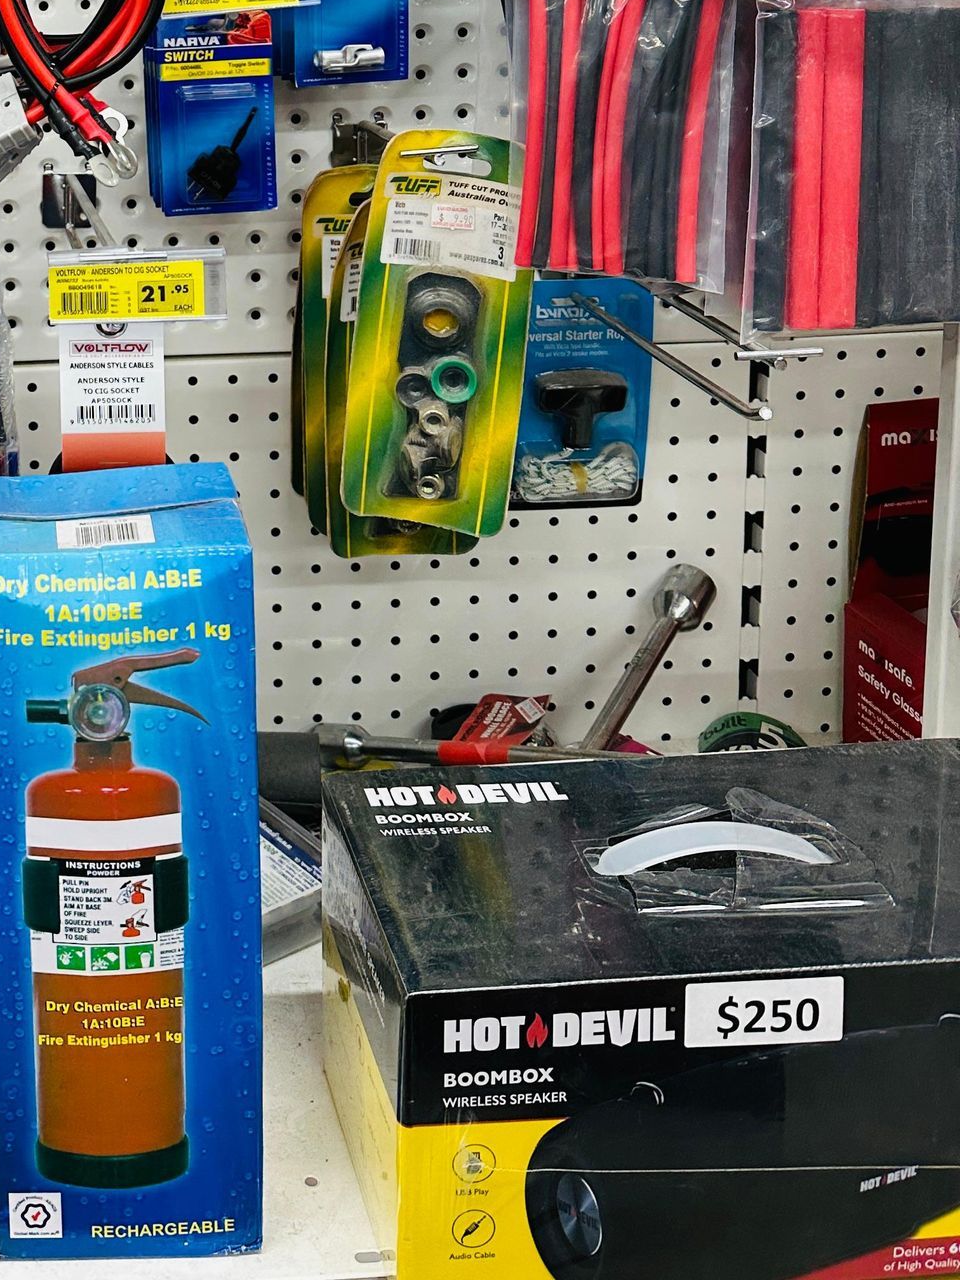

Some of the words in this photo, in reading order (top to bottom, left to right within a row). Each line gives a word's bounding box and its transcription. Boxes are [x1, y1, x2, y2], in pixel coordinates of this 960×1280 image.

[164, 36, 220, 46] NARVA
[164, 50, 214, 62] SWITCH
[390, 177, 441, 194] TUFF
[448, 181, 469, 189] TUFF
[471, 183, 488, 192] CUT
[448, 190, 496, 203] Australian
[566, 330, 603, 341] Starter
[36, 571, 136, 592] Chemical
[144, 570, 202, 588] A:B:E
[46, 603, 142, 622] 1A:10B:E
[42, 624, 178, 650] Extinguisher
[186, 624, 195, 639] 1
[205, 622, 231, 641] kg
[858, 664, 890, 700] Safety
[65, 860, 140, 869] INSTRUCTIONS
[717, 996, 819, 1040] $250
[444, 1016, 525, 1053] HOT
[553, 1008, 676, 1048] DEVIL
[444, 1068, 553, 1087] BOOMBOX
[443, 1094, 507, 1108] WIRELESS
[509, 1092, 567, 1105] SPEAKER
[91, 1217, 235, 1238] RECHARGEABLE
[449, 1252, 471, 1260] Audio
[474, 1251, 496, 1259] Cable
[893, 1245, 946, 1259] Delivers
